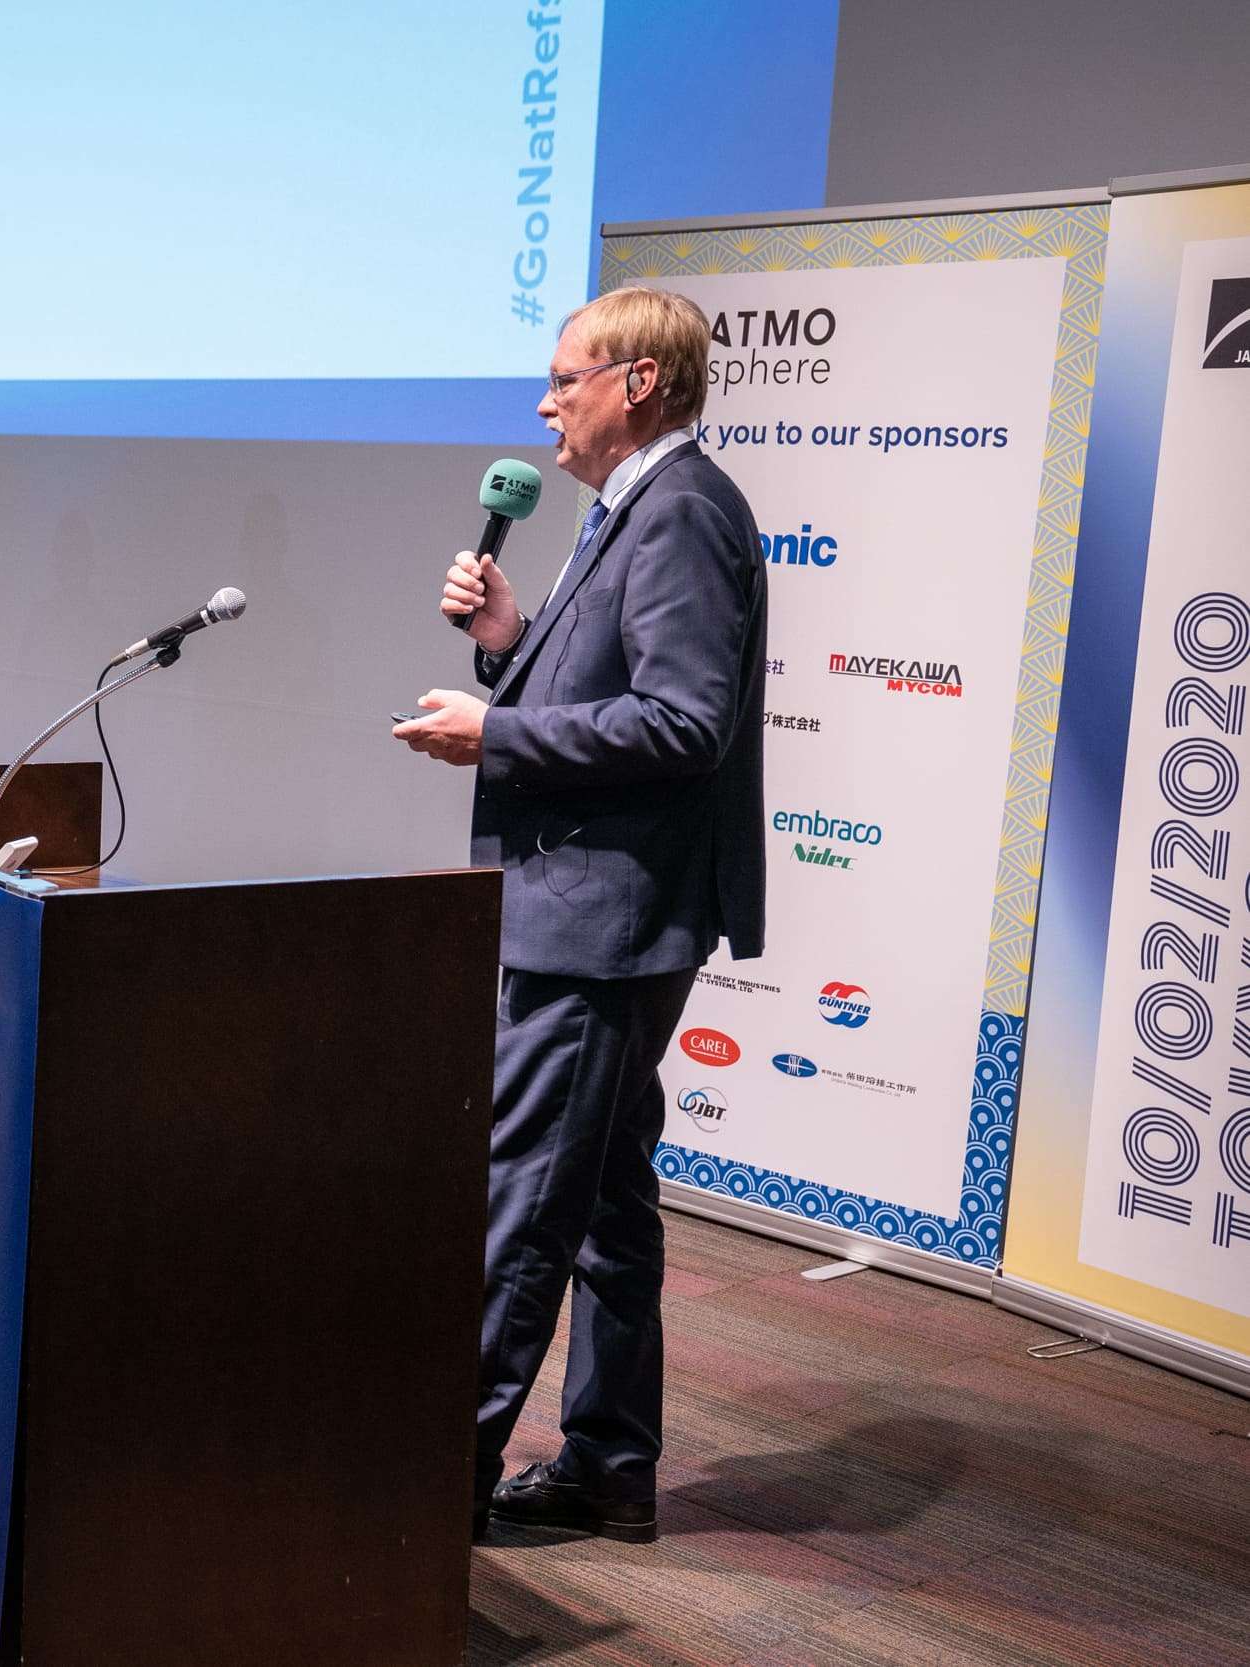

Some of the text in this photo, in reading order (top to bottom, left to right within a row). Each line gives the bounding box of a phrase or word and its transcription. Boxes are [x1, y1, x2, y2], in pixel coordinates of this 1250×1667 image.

[511, 0, 561, 328] #GoNatRef
[711, 308, 836, 348] ATMO
[708, 348, 831, 396] sphere
[718, 425, 766, 450] you
[776, 421, 802, 445] to
[811, 424, 860, 446] our
[868, 424, 1008, 452] sponsors
[508, 479, 537, 494] ATMO
[829, 654, 963, 685] MAYEKAWA
[887, 679, 963, 698] MYCOM
[773, 810, 882, 846] embraco
[790, 843, 858, 871] Nidec
[1119, 592, 1250, 1226] 10/02/2020
[713, 974, 736, 984] HEAVY
[737, 979, 781, 994] INDUSTRIES
[818, 996, 871, 1015] GÜNTNER
[690, 1035, 729, 1056] CAREL
[694, 1102, 727, 1121] JBT
